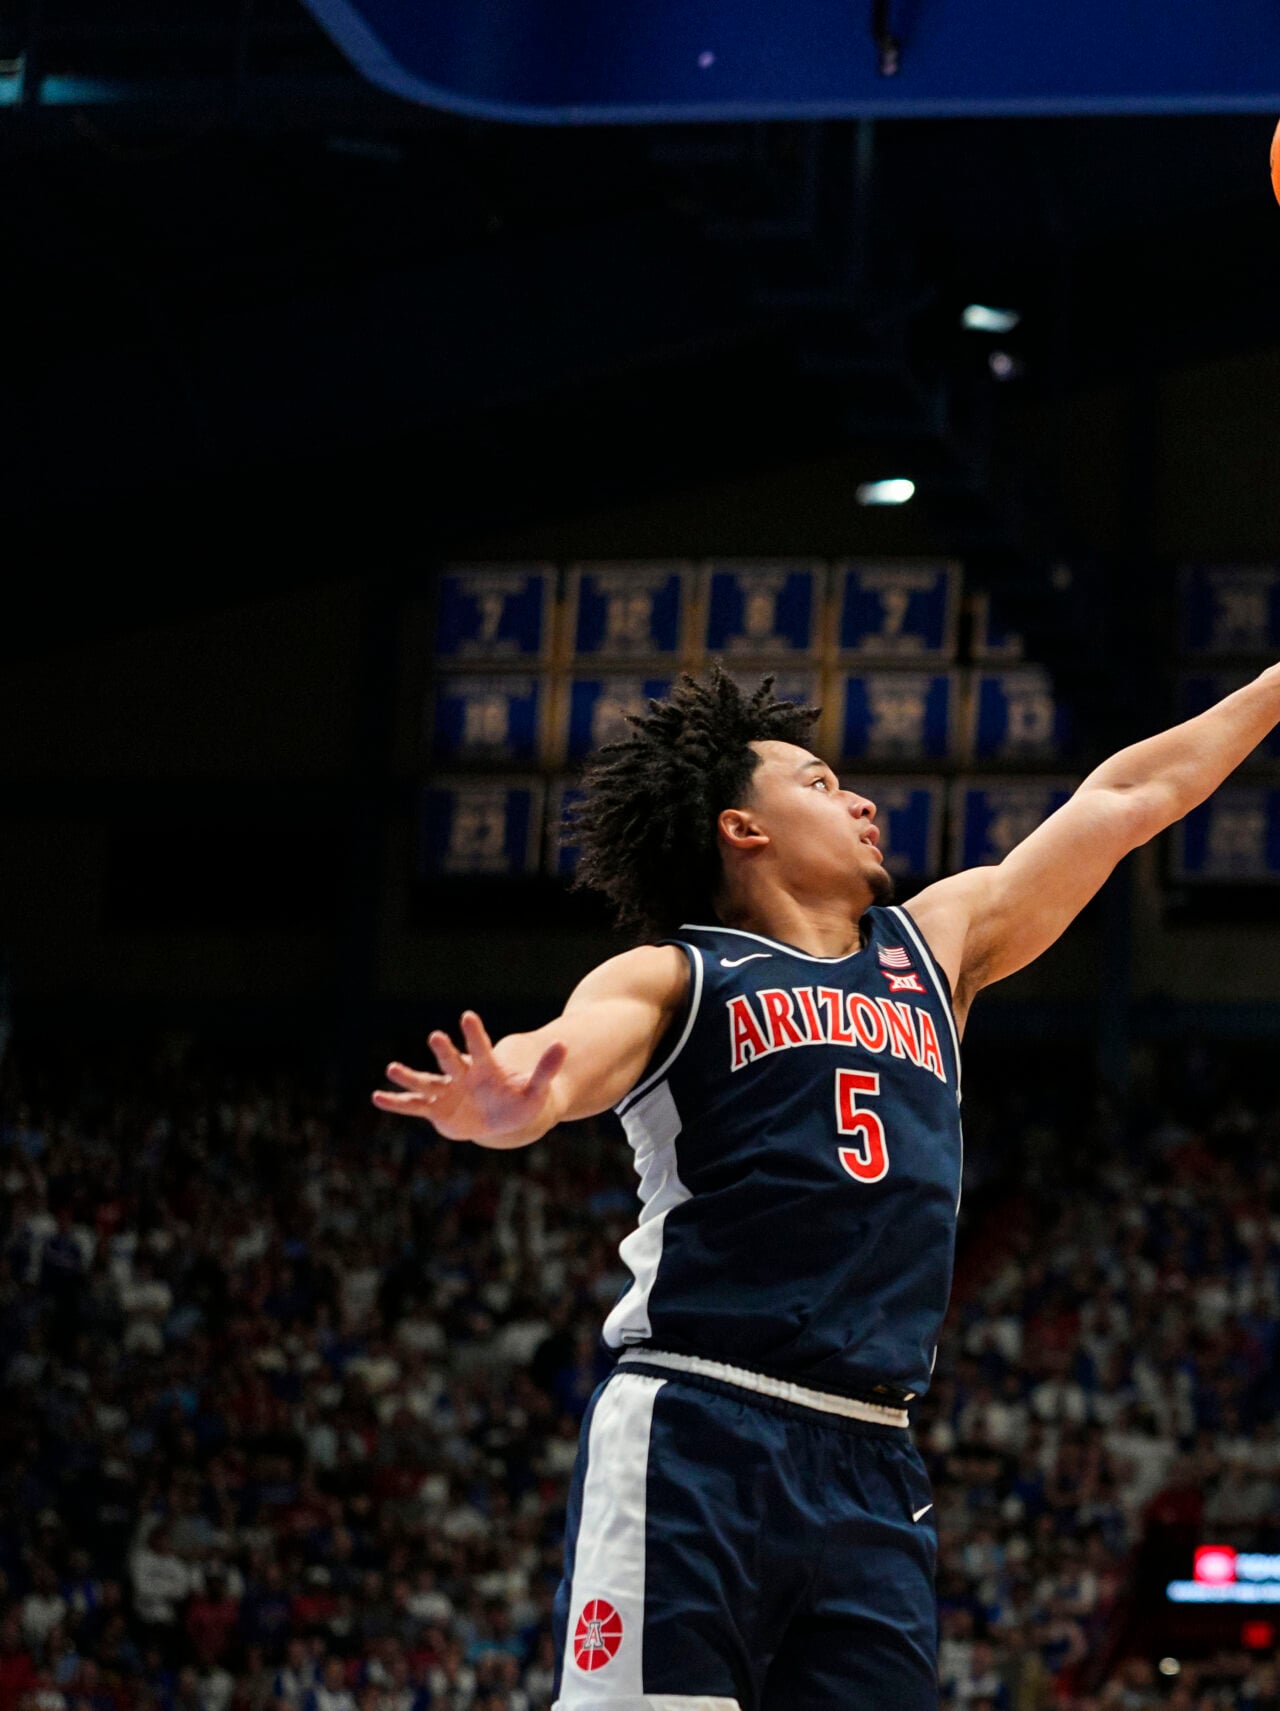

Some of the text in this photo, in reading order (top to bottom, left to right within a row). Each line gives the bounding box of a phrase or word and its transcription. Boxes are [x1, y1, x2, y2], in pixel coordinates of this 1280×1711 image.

[726, 986, 947, 1083] ARIZONA
[835, 1068, 889, 1184] 5
[583, 1621, 604, 1649] A
